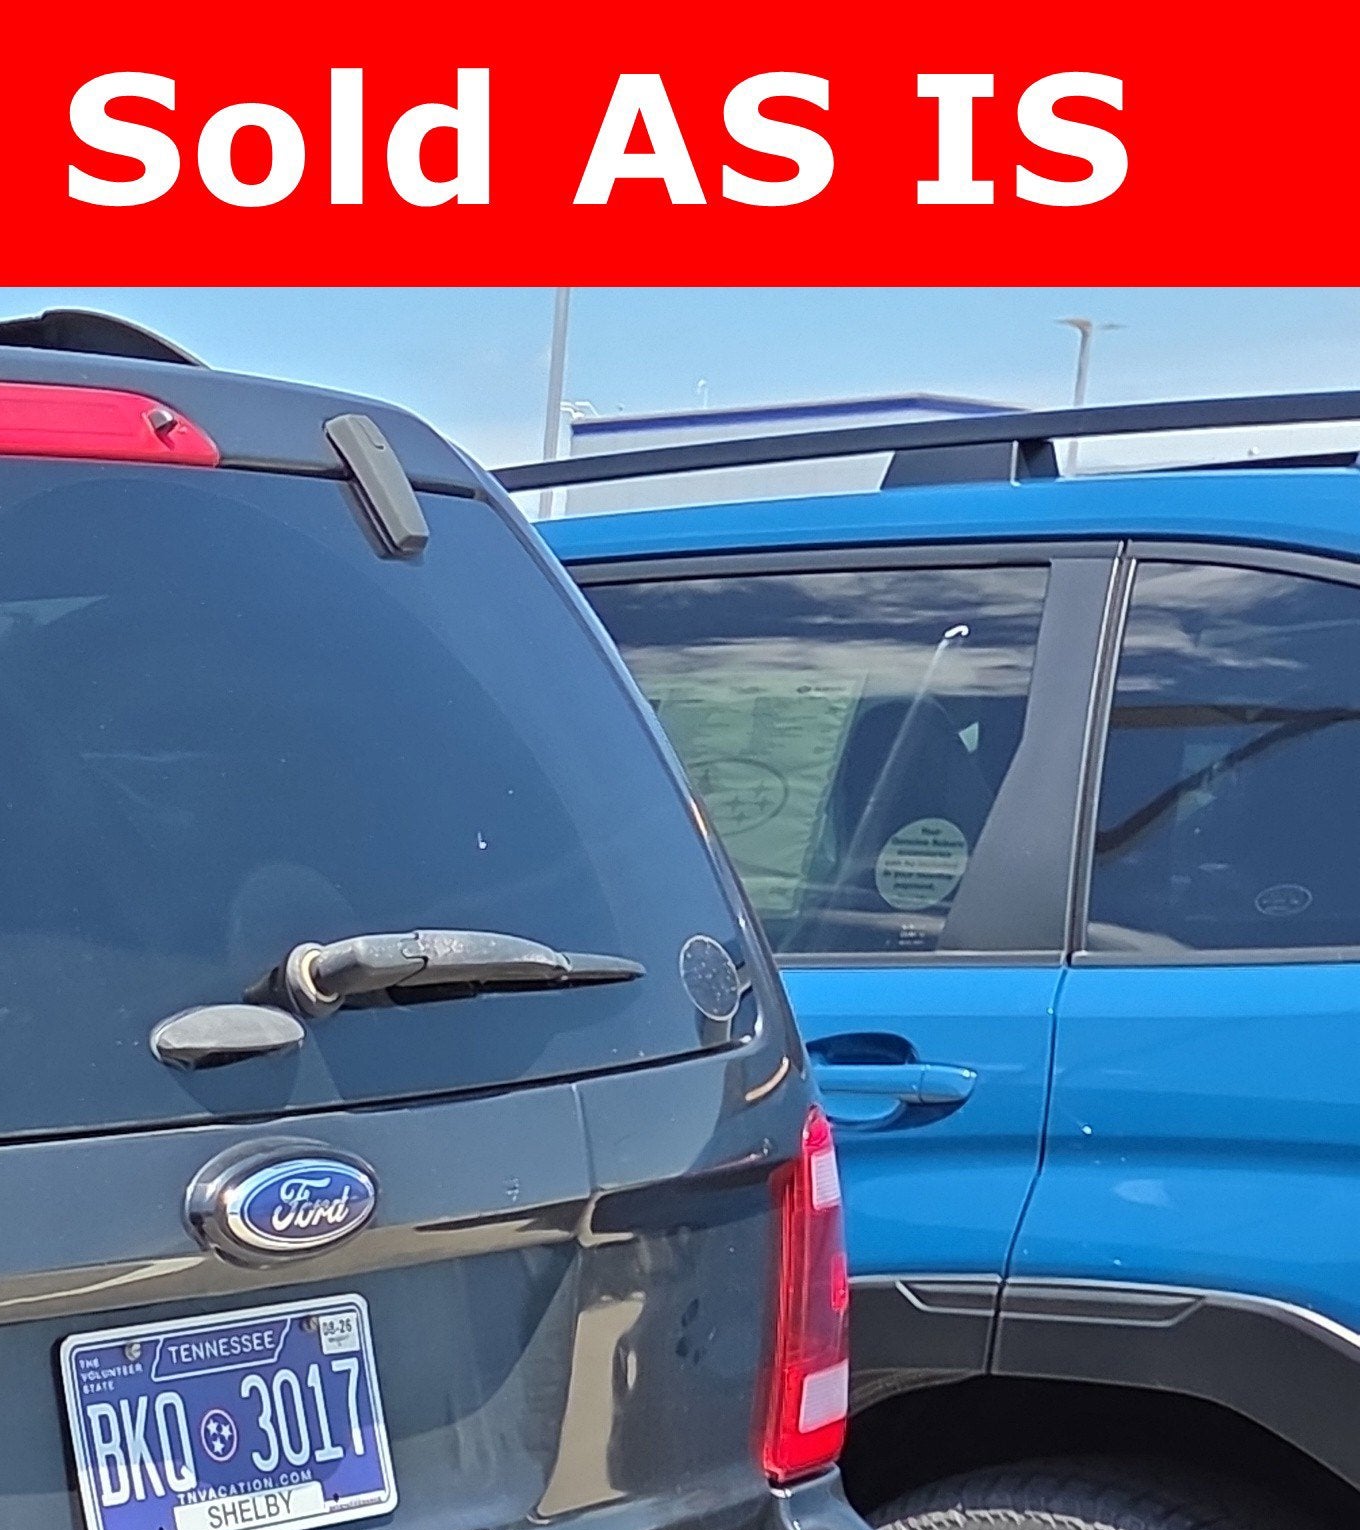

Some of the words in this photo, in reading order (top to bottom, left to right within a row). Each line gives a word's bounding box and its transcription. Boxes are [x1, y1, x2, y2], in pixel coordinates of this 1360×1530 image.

[271, 1176, 351, 1231] Ford
[79, 1358, 100, 1370] THE
[168, 1330, 275, 1364] TENNESSEE
[81, 1363, 144, 1383] VOLUNTEER
[82, 1381, 115, 1395] STATE
[86, 1391, 198, 1507] BKQ
[240, 1357, 365, 1472] 3017
[177, 1470, 313, 1506] TNVACATION.COM
[207, 1491, 295, 1529] SHELBY
